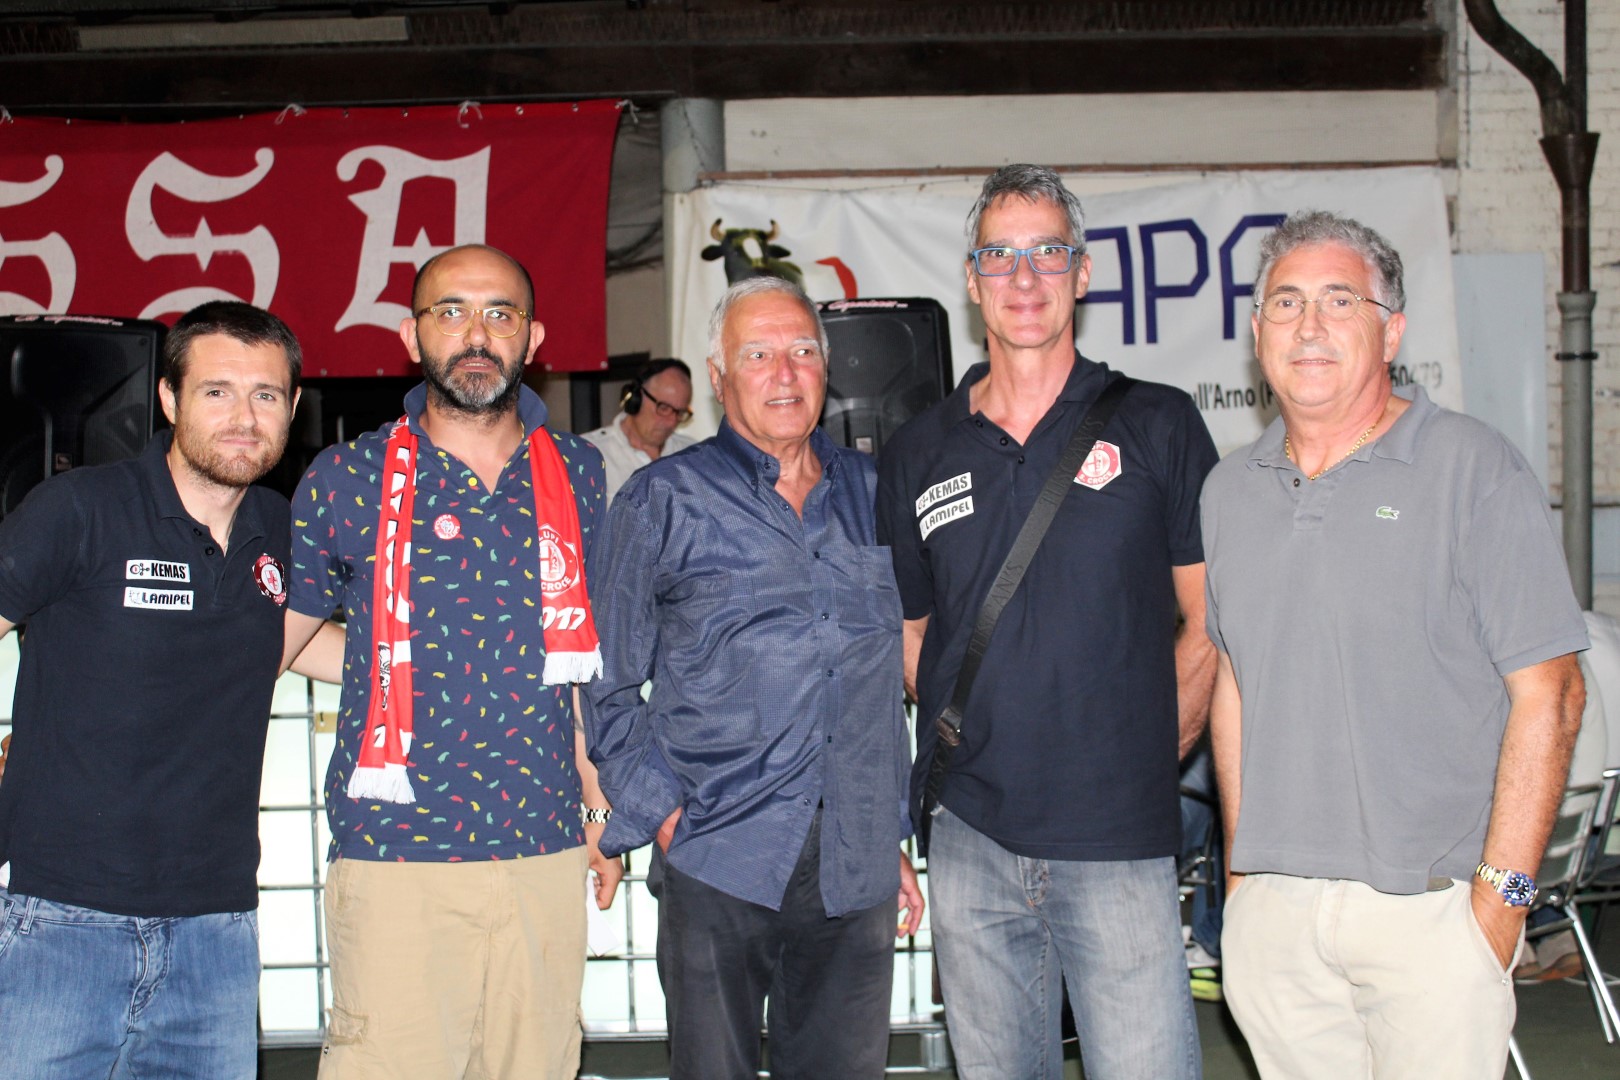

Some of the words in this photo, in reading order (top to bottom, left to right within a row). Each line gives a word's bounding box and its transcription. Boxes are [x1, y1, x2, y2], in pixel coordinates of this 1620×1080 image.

[929, 475, 968, 503] KEMAS
[926, 500, 970, 530] LAMIPEL
[538, 530, 559, 544] LUPI
[151, 562, 187, 580] KEMAS
[541, 575, 571, 591] CROCE
[142, 589, 191, 606] LAMIPEL
